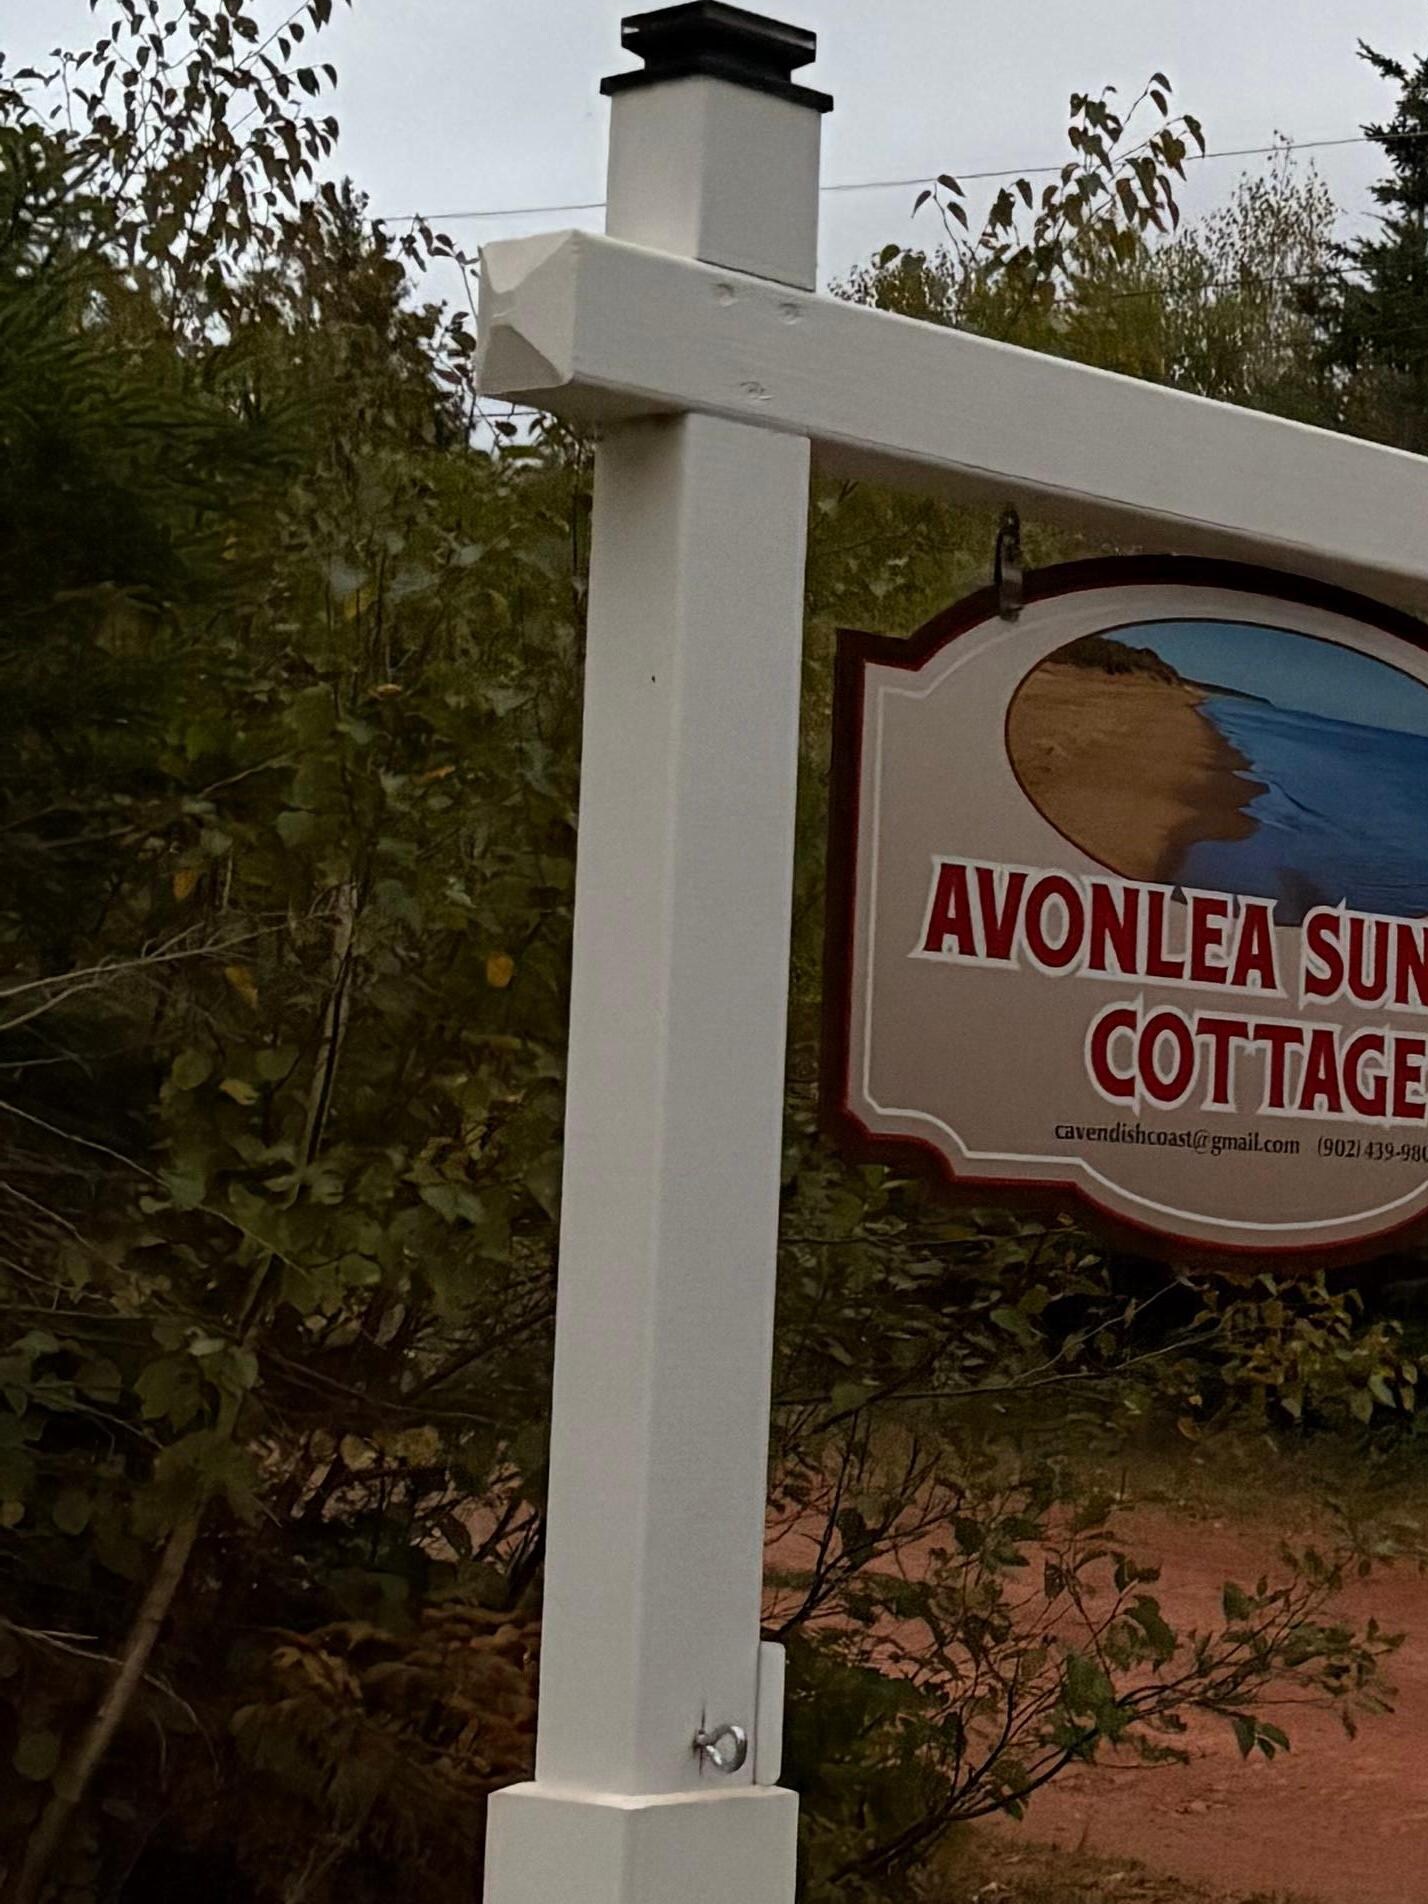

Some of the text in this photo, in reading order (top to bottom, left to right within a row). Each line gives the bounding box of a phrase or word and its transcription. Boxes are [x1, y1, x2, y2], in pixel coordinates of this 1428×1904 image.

[915, 859, 1281, 995] AVONLEA
[1055, 1123, 1300, 1156] cavendishcoast@gmail.com
[1317, 1135, 1361, 1158] (902)
